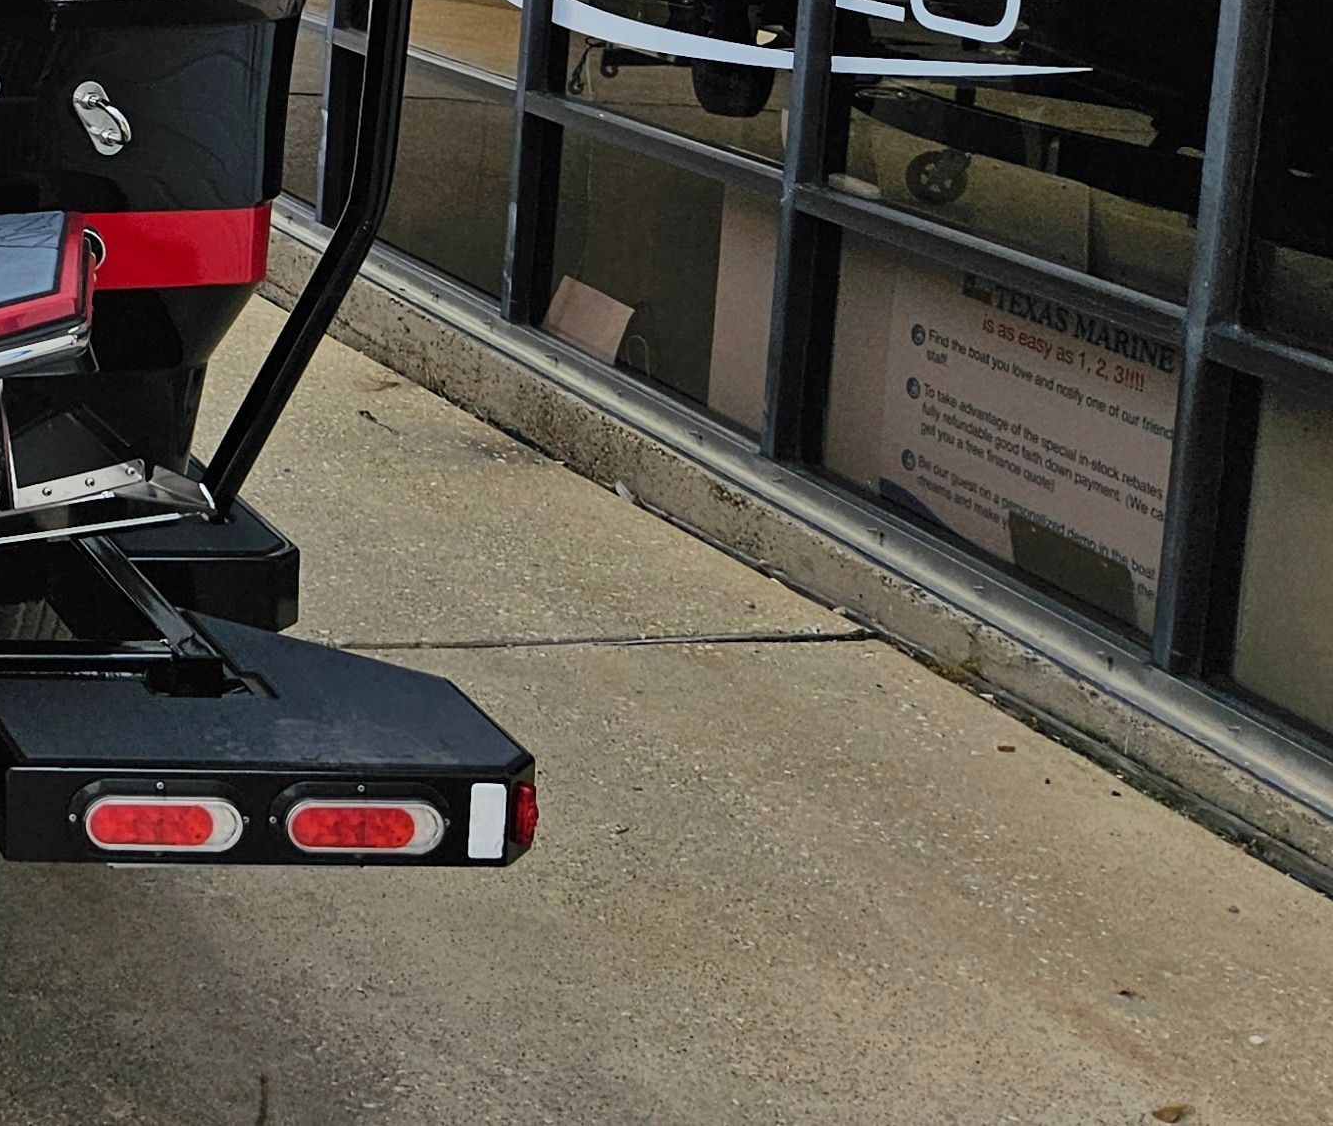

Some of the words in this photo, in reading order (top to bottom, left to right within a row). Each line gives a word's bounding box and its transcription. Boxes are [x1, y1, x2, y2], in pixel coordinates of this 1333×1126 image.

[982, 313, 995, 334] is
[997, 322, 1015, 342] as
[1017, 331, 1052, 360] easy
[1055, 345, 1074, 365] as
[994, 284, 1071, 332] TEXAS
[1074, 312, 1175, 374] MARINE
[968, 345, 990, 365] boat
[991, 354, 1010, 373] you
